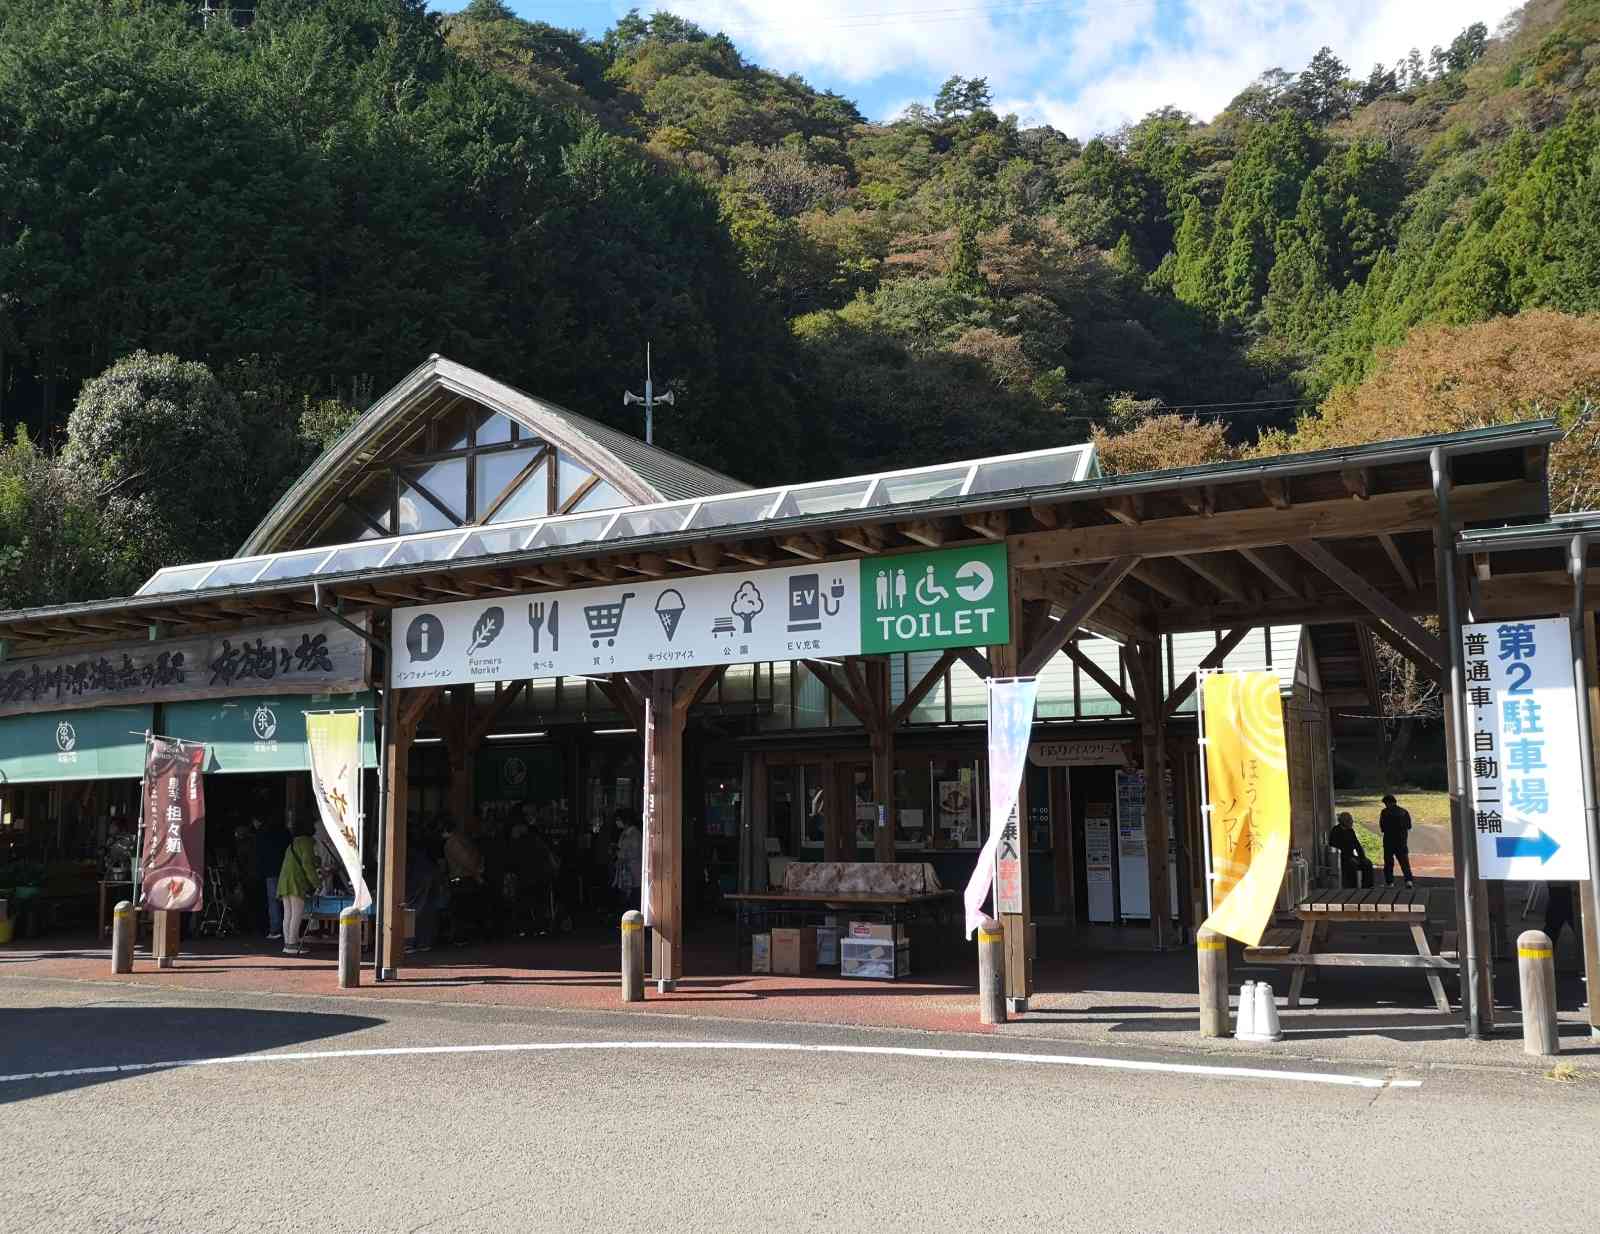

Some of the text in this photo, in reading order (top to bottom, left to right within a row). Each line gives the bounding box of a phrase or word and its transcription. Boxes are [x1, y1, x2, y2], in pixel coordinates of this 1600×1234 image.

[792, 589, 815, 607] EV
[876, 607, 995, 640] TOILET
[468, 657, 502, 666] Farmers
[533, 660, 554, 670] 食べる
[397, 669, 452, 681] インフォメーション
[470, 666, 500, 675] Market
[1496, 623, 1549, 815] 第2駐車場
[1464, 632, 1503, 834] 普通車・自動二輪
